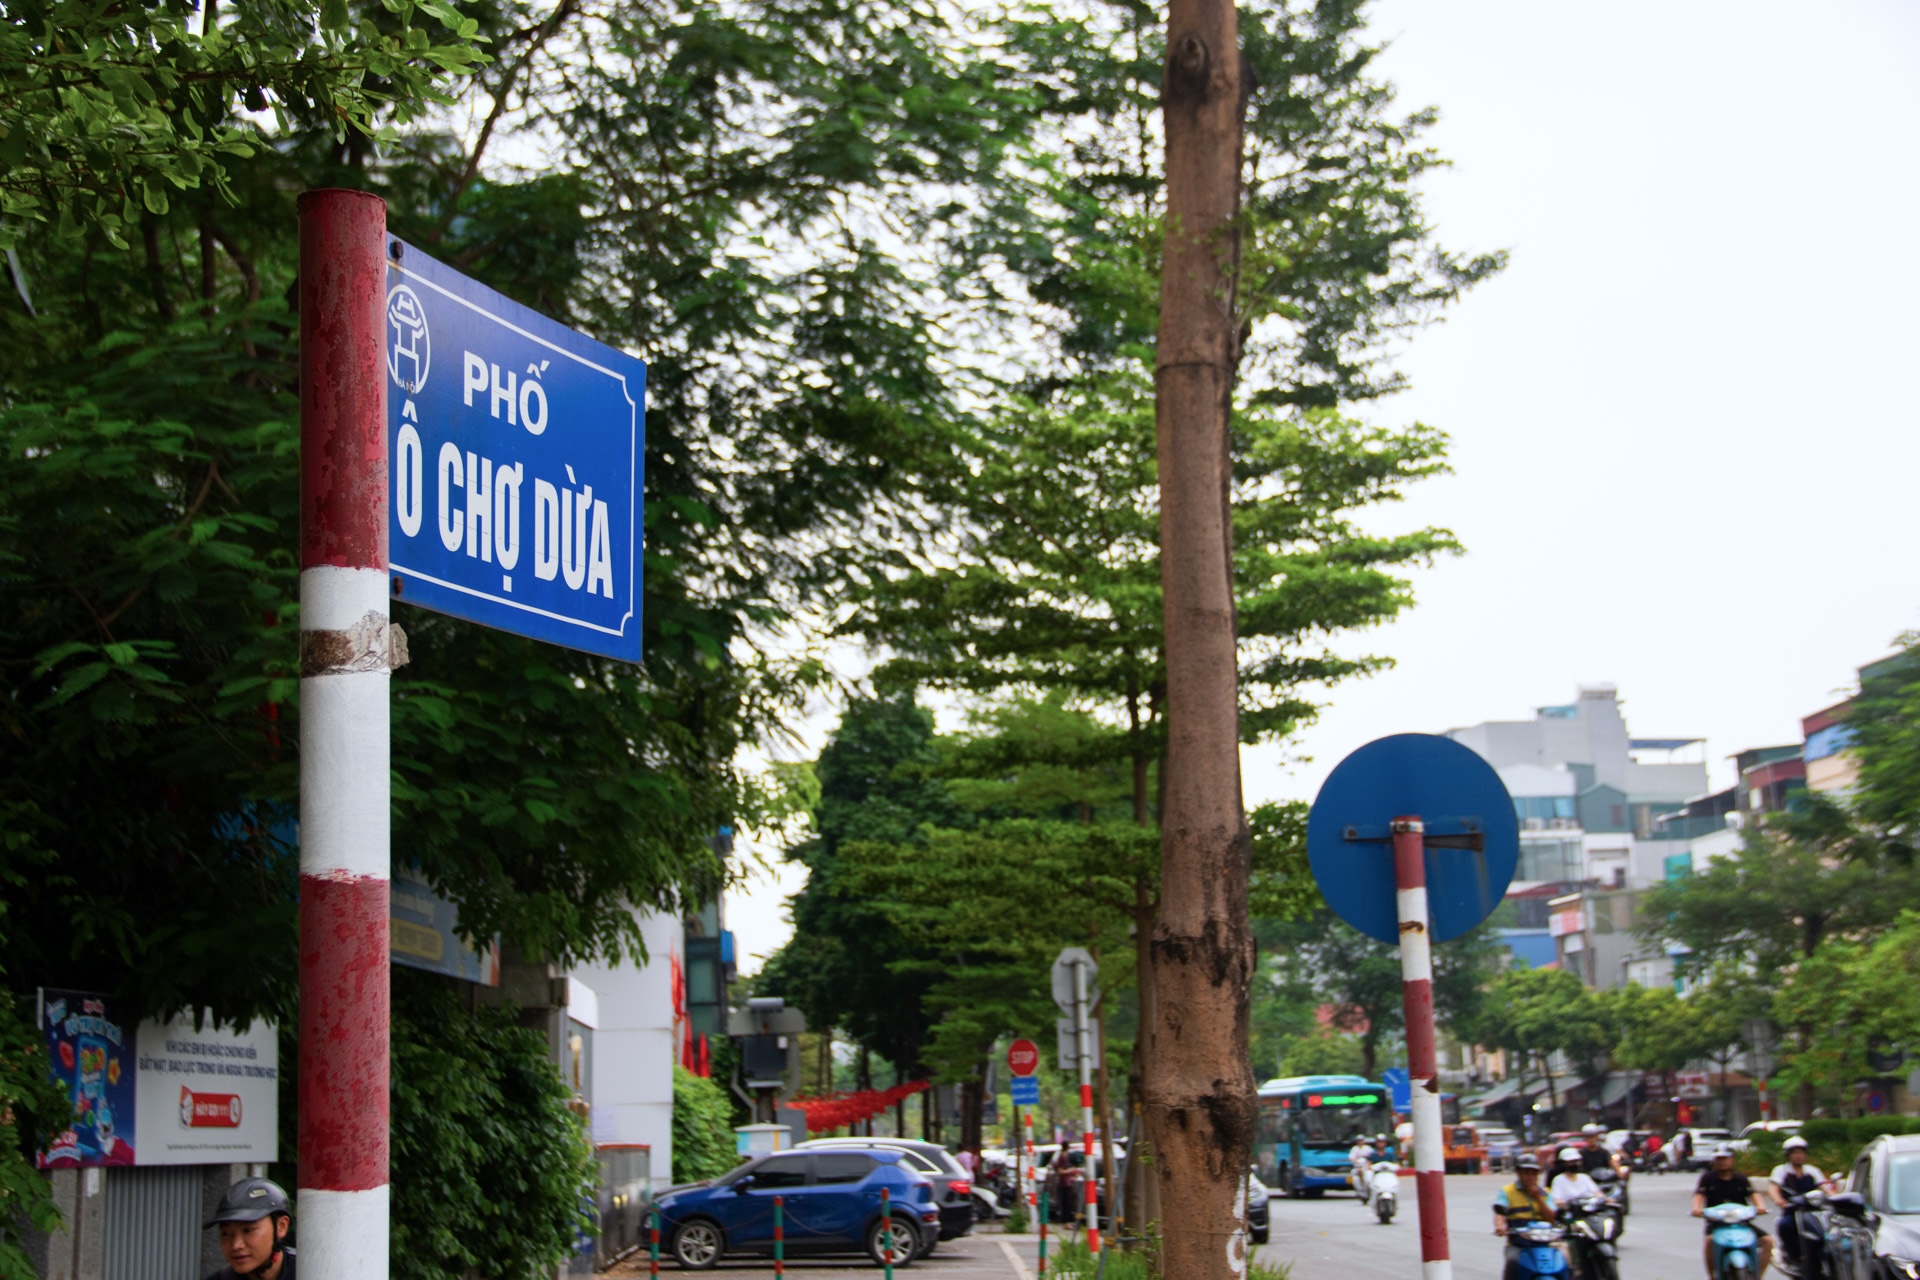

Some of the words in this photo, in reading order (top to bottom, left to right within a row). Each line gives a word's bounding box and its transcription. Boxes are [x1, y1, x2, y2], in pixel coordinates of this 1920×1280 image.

[463, 350, 550, 436] PHỐ
[396, 399, 423, 538] Ô
[438, 441, 524, 593] CHỢ
[534, 463, 614, 600] DỪA
[1011, 1050, 1035, 1064] STOP
